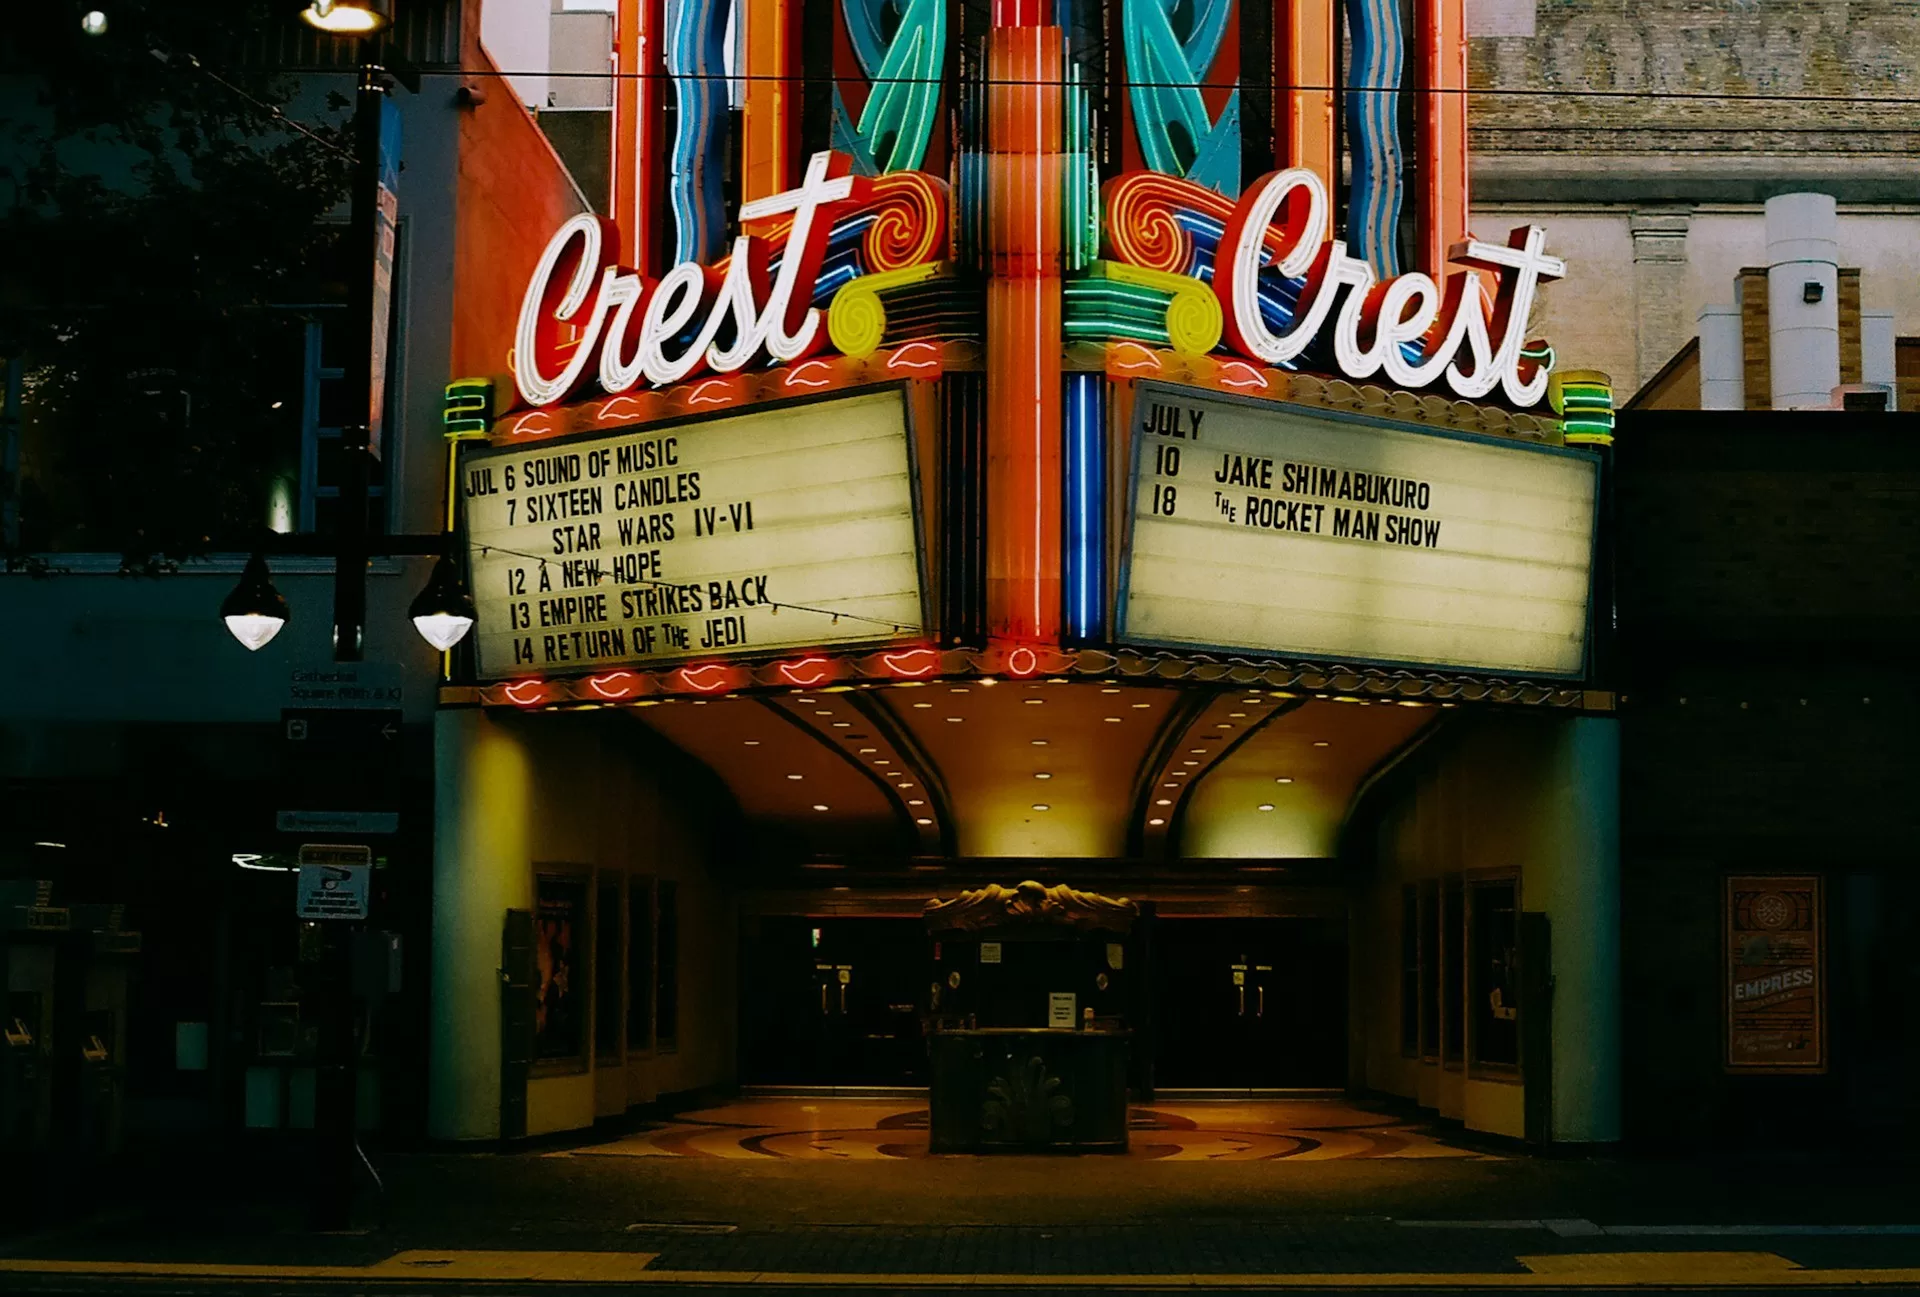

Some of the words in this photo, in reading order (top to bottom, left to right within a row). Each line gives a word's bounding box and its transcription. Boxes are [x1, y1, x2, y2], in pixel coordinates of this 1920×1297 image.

[514, 149, 855, 408] Crest
[1228, 167, 1566, 408] Crest
[1142, 403, 1204, 441] JULY
[466, 468, 498, 498] JUL
[504, 464, 516, 492] 6
[524, 455, 581, 488] SOUND
[587, 448, 611, 479] OF
[617, 437, 678, 475] MUSIC
[1155, 444, 1181, 477] 10
[1215, 454, 1273, 490] JAKE
[1282, 464, 1431, 512] SHIMABUKURO
[506, 499, 517, 526] 7
[526, 485, 602, 524] SIXTEEN
[614, 471, 701, 512] CANDLES
[1152, 484, 1177, 516] 18
[1214, 491, 1237, 523] THE
[1245, 496, 1325, 534] ROCKET
[1332, 508, 1380, 542] MAN
[1384, 516, 1441, 548] SHOW
[552, 523, 602, 555] STAR
[617, 513, 675, 546] WARS
[694, 501, 754, 537] IV-VI
[508, 568, 527, 596] 12
[538, 562, 552, 593] A
[562, 560, 602, 589] NEW
[612, 550, 662, 584] HOPE
[510, 603, 531, 630] 13
[540, 594, 608, 627] EMPIRE
[622, 583, 703, 619] STRIKES
[709, 575, 769, 611] BACK
[513, 638, 534, 665] 14
[544, 629, 626, 662] RETURN
[632, 625, 657, 655] OF
[661, 622, 690, 651] THE
[700, 615, 746, 648] JEDI
[1734, 967, 1813, 1000] EMPRESS
